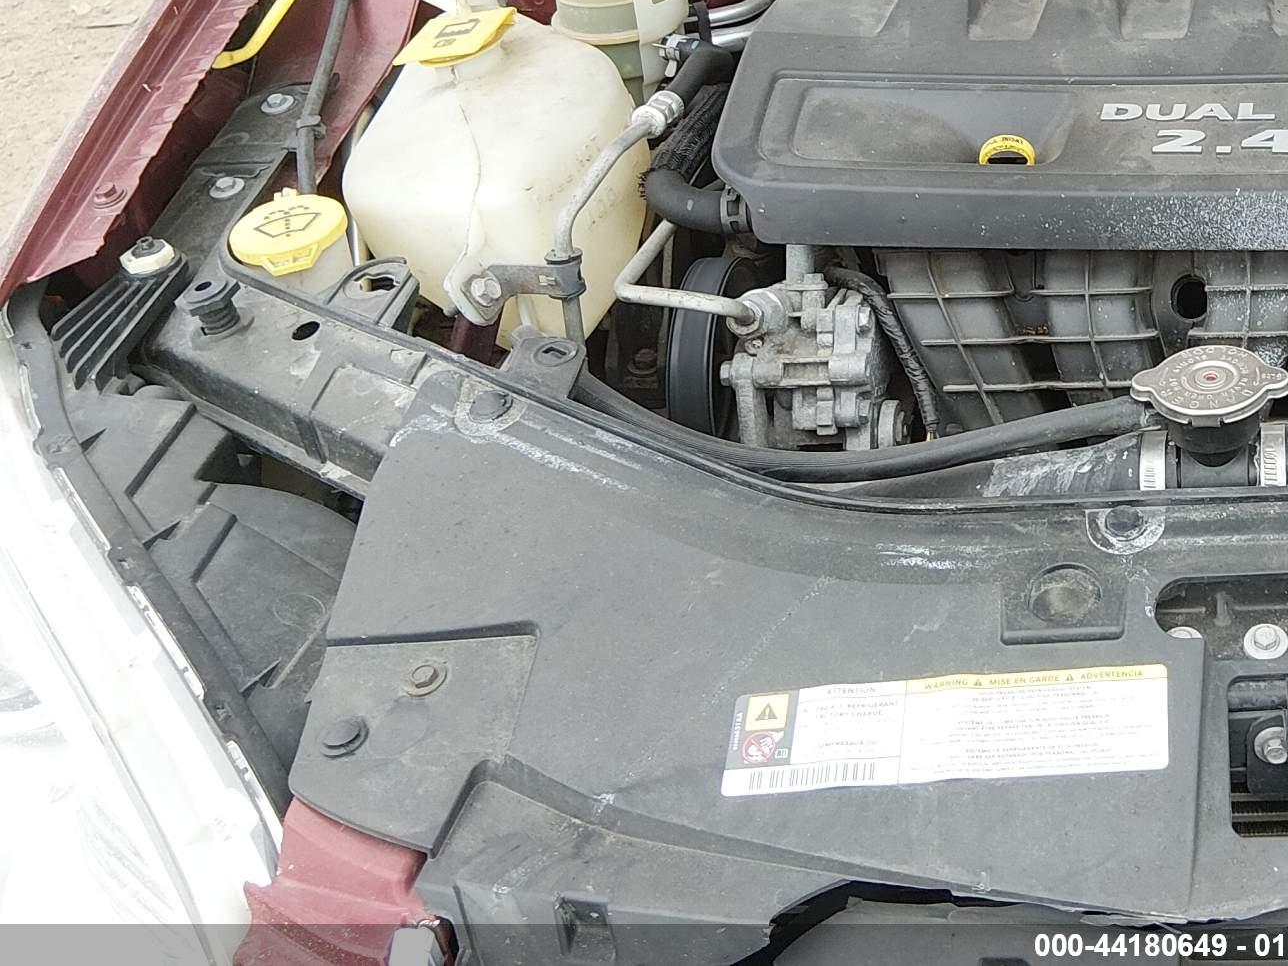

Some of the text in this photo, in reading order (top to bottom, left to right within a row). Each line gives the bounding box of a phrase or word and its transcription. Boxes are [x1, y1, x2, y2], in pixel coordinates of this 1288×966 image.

[1099, 102, 1276, 122] DUAL
[1160, 388, 1254, 409] DANGER
[924, 670, 1143, 690] WARNING MISE EN GARDE ADVERTENCIA
